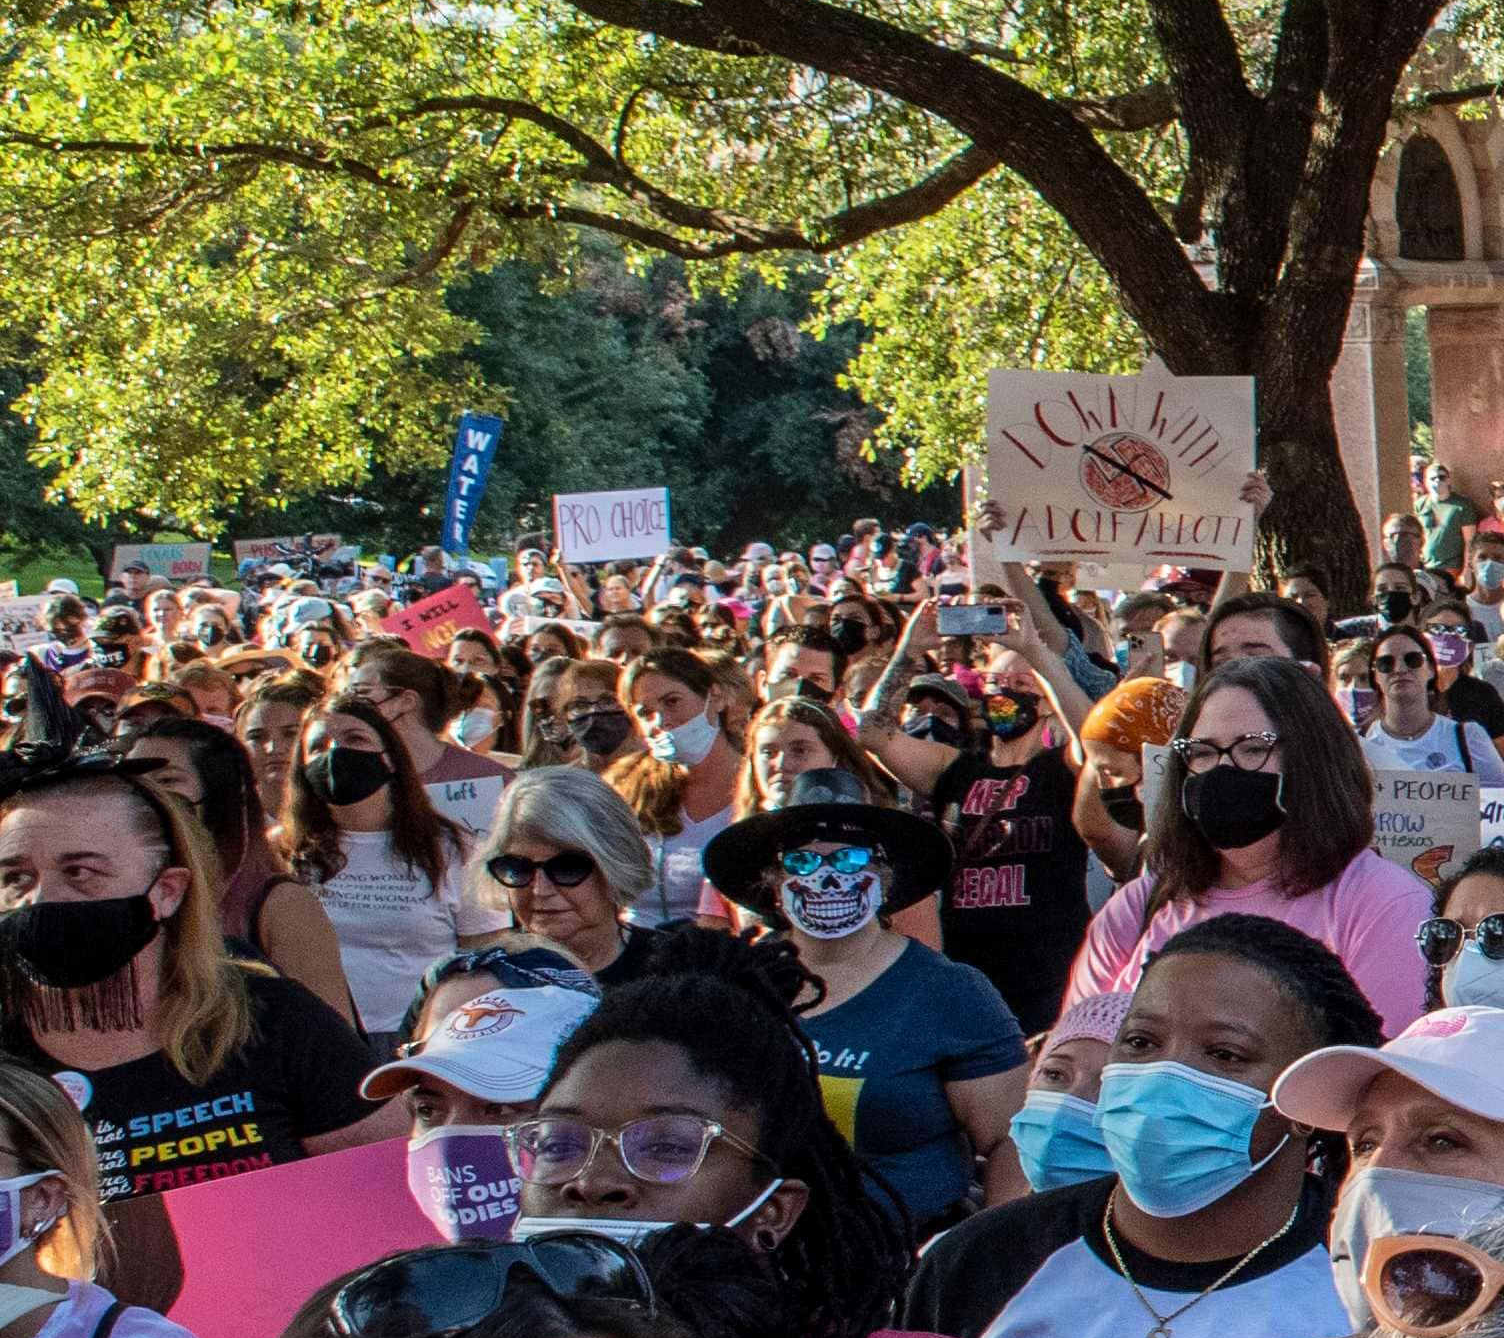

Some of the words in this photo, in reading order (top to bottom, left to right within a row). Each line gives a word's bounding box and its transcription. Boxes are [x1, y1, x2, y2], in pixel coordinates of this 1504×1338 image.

[452, 426, 492, 544] WATER
[558, 503, 600, 551] PRO
[610, 499, 667, 540] CHOICE
[1010, 504, 1123, 546] ADOLF
[1134, 512, 1244, 546] ABBOTT
[962, 774, 1032, 816] KEP
[1392, 779, 1474, 802] PEOPLE
[1374, 812, 1426, 833] ROW
[128, 1091, 256, 1138] SPEECH
[130, 1122, 264, 1168] PEOPLE
[440, 1197, 519, 1227] ODIES
